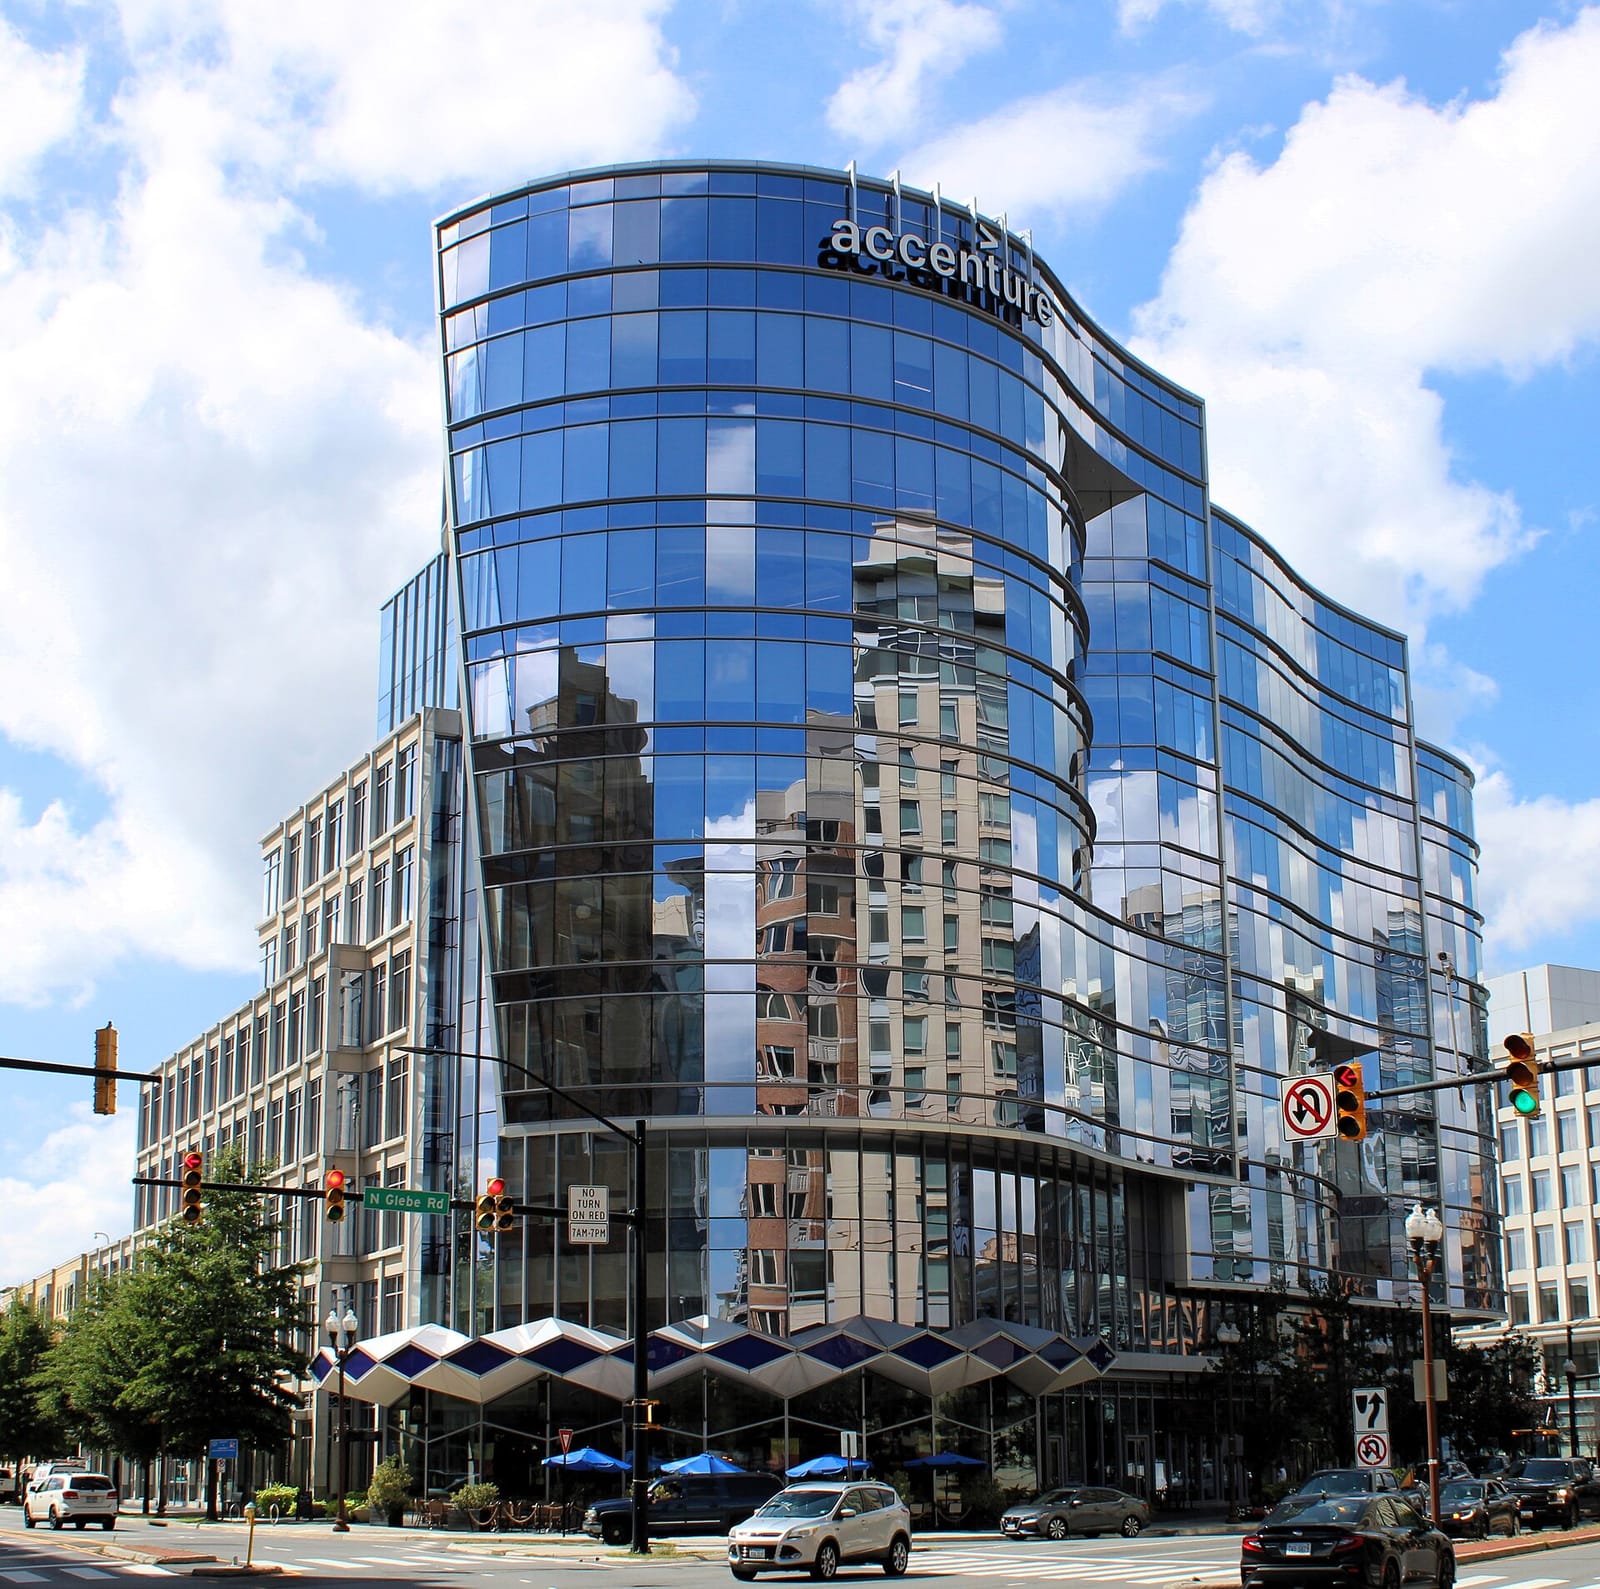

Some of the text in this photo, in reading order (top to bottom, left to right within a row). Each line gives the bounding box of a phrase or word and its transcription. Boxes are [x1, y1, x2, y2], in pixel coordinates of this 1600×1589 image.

[831, 219, 1052, 327] accenture
[582, 1189, 594, 1197] NO
[370, 1193, 444, 1209] N Glebe Rd
[577, 1200, 600, 1208] TURN
[572, 1211, 605, 1219] ON RED
[572, 1229, 606, 1237] 7AM-7PM
